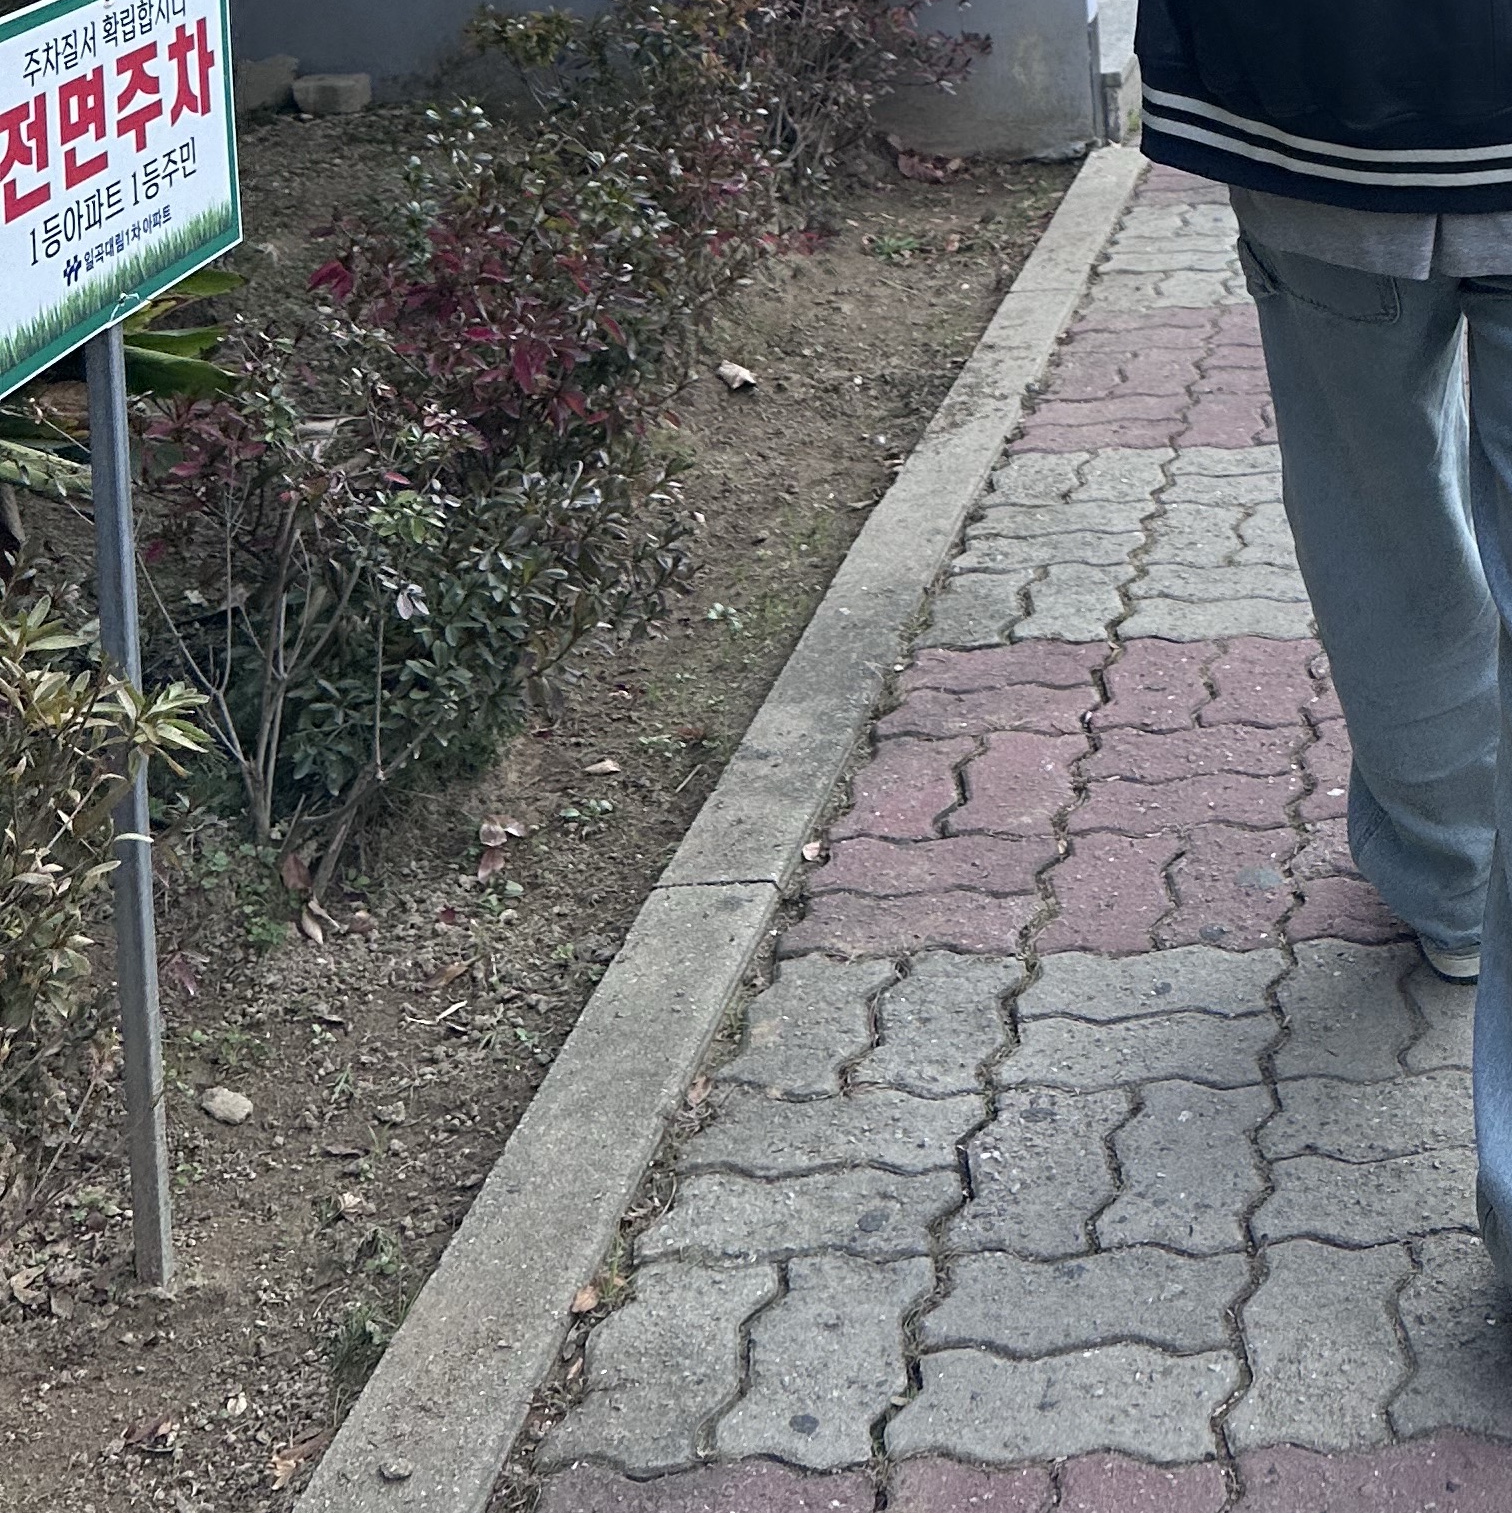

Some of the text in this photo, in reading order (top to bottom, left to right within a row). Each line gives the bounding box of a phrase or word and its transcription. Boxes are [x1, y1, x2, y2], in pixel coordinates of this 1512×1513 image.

[23, 21, 97, 87] 주차질서
[0, 16, 215, 225] 전면주차
[29, 136, 197, 267] 1등아파트 1등주민
